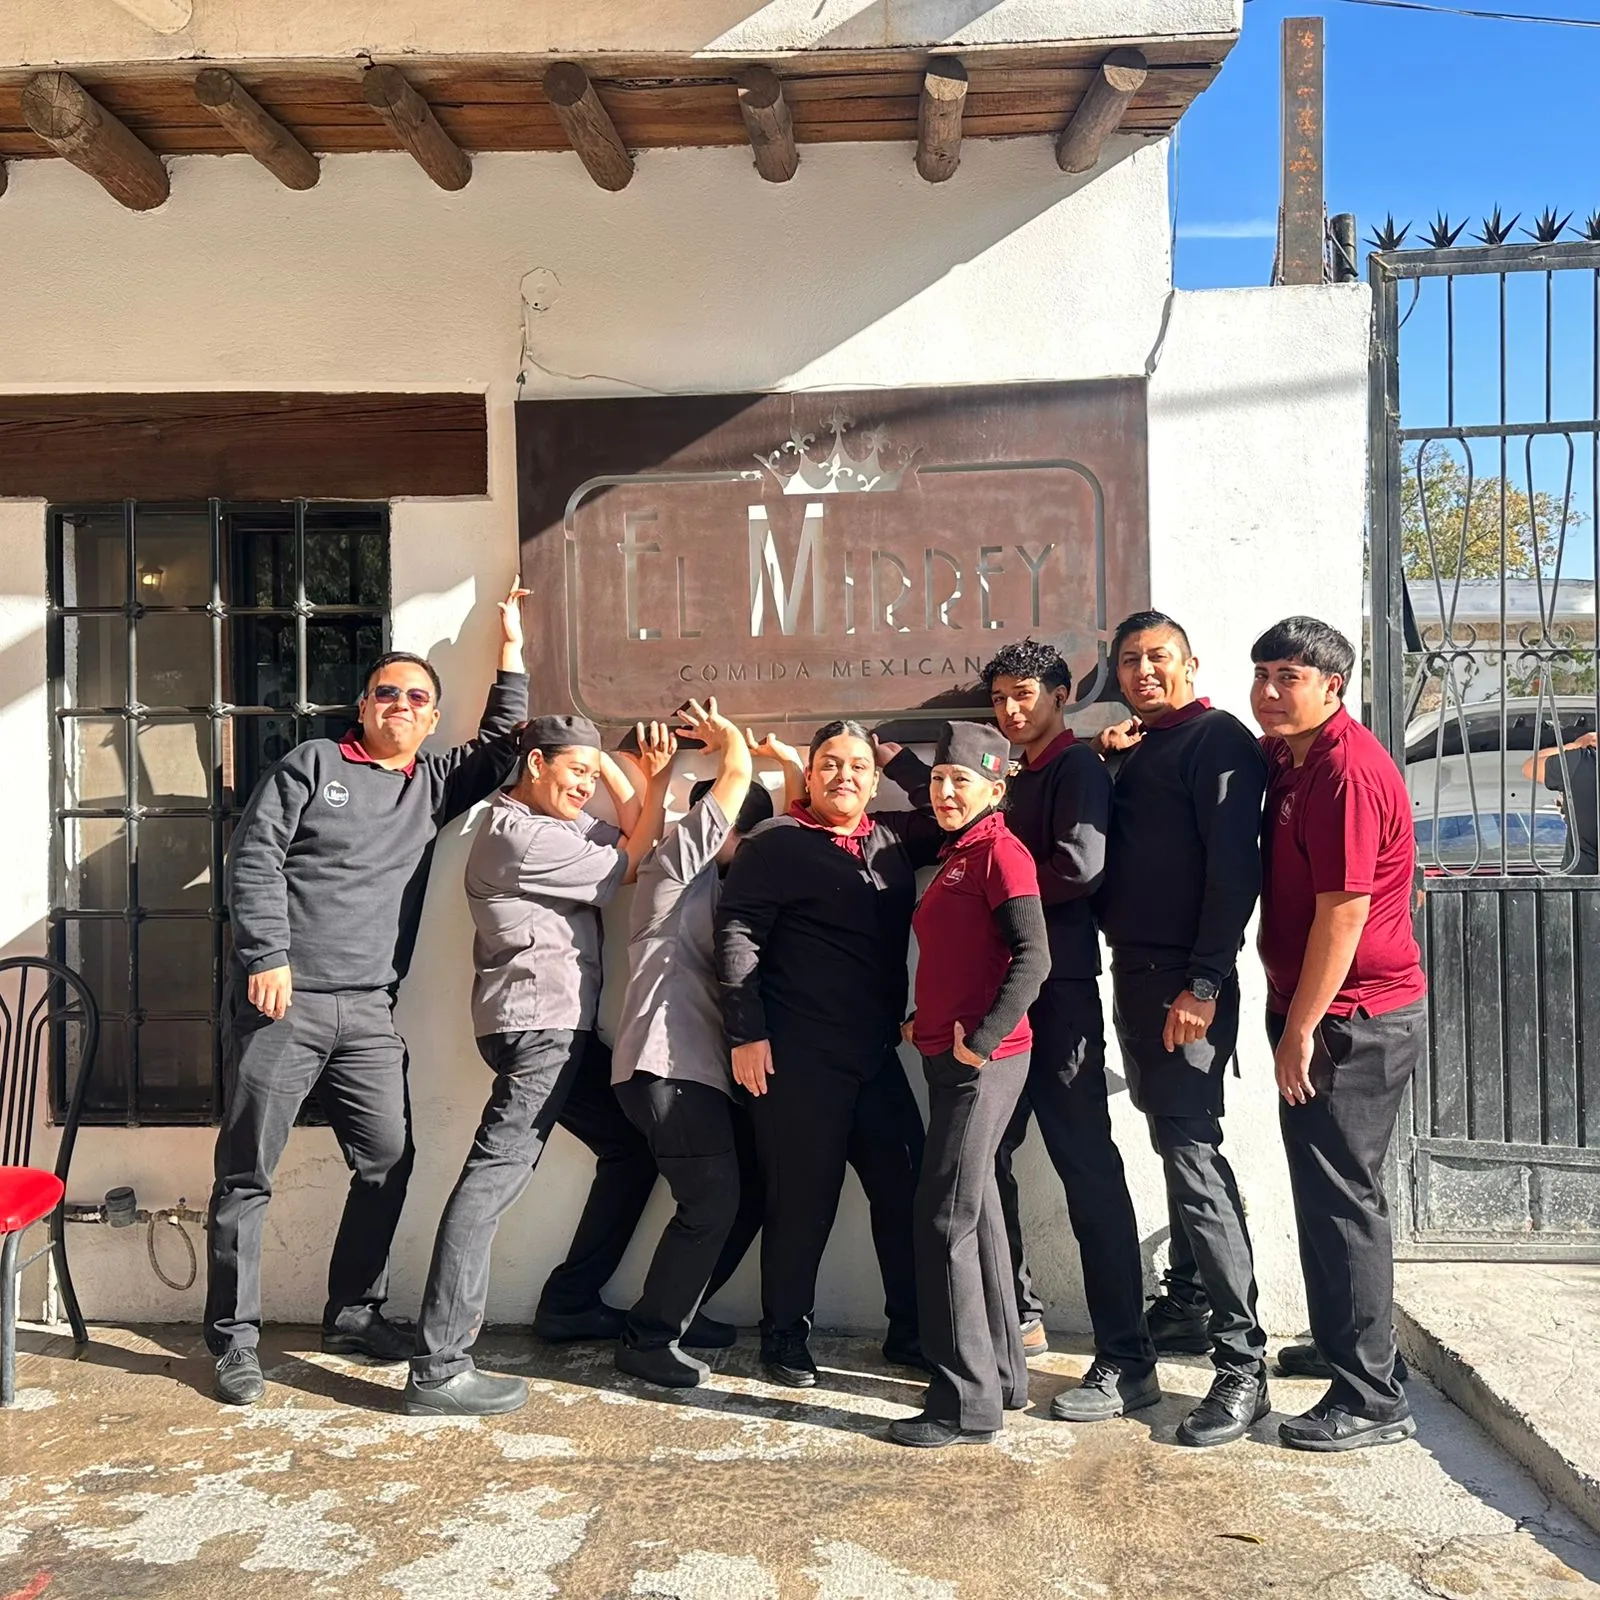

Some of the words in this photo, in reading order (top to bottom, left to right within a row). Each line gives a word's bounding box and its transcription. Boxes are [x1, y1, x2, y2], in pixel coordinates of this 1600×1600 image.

[618, 511, 702, 640] EL
[748, 503, 1055, 636] MIRREY
[679, 662, 810, 681] COMIDA
[832, 657, 981, 678] MEXICAN
